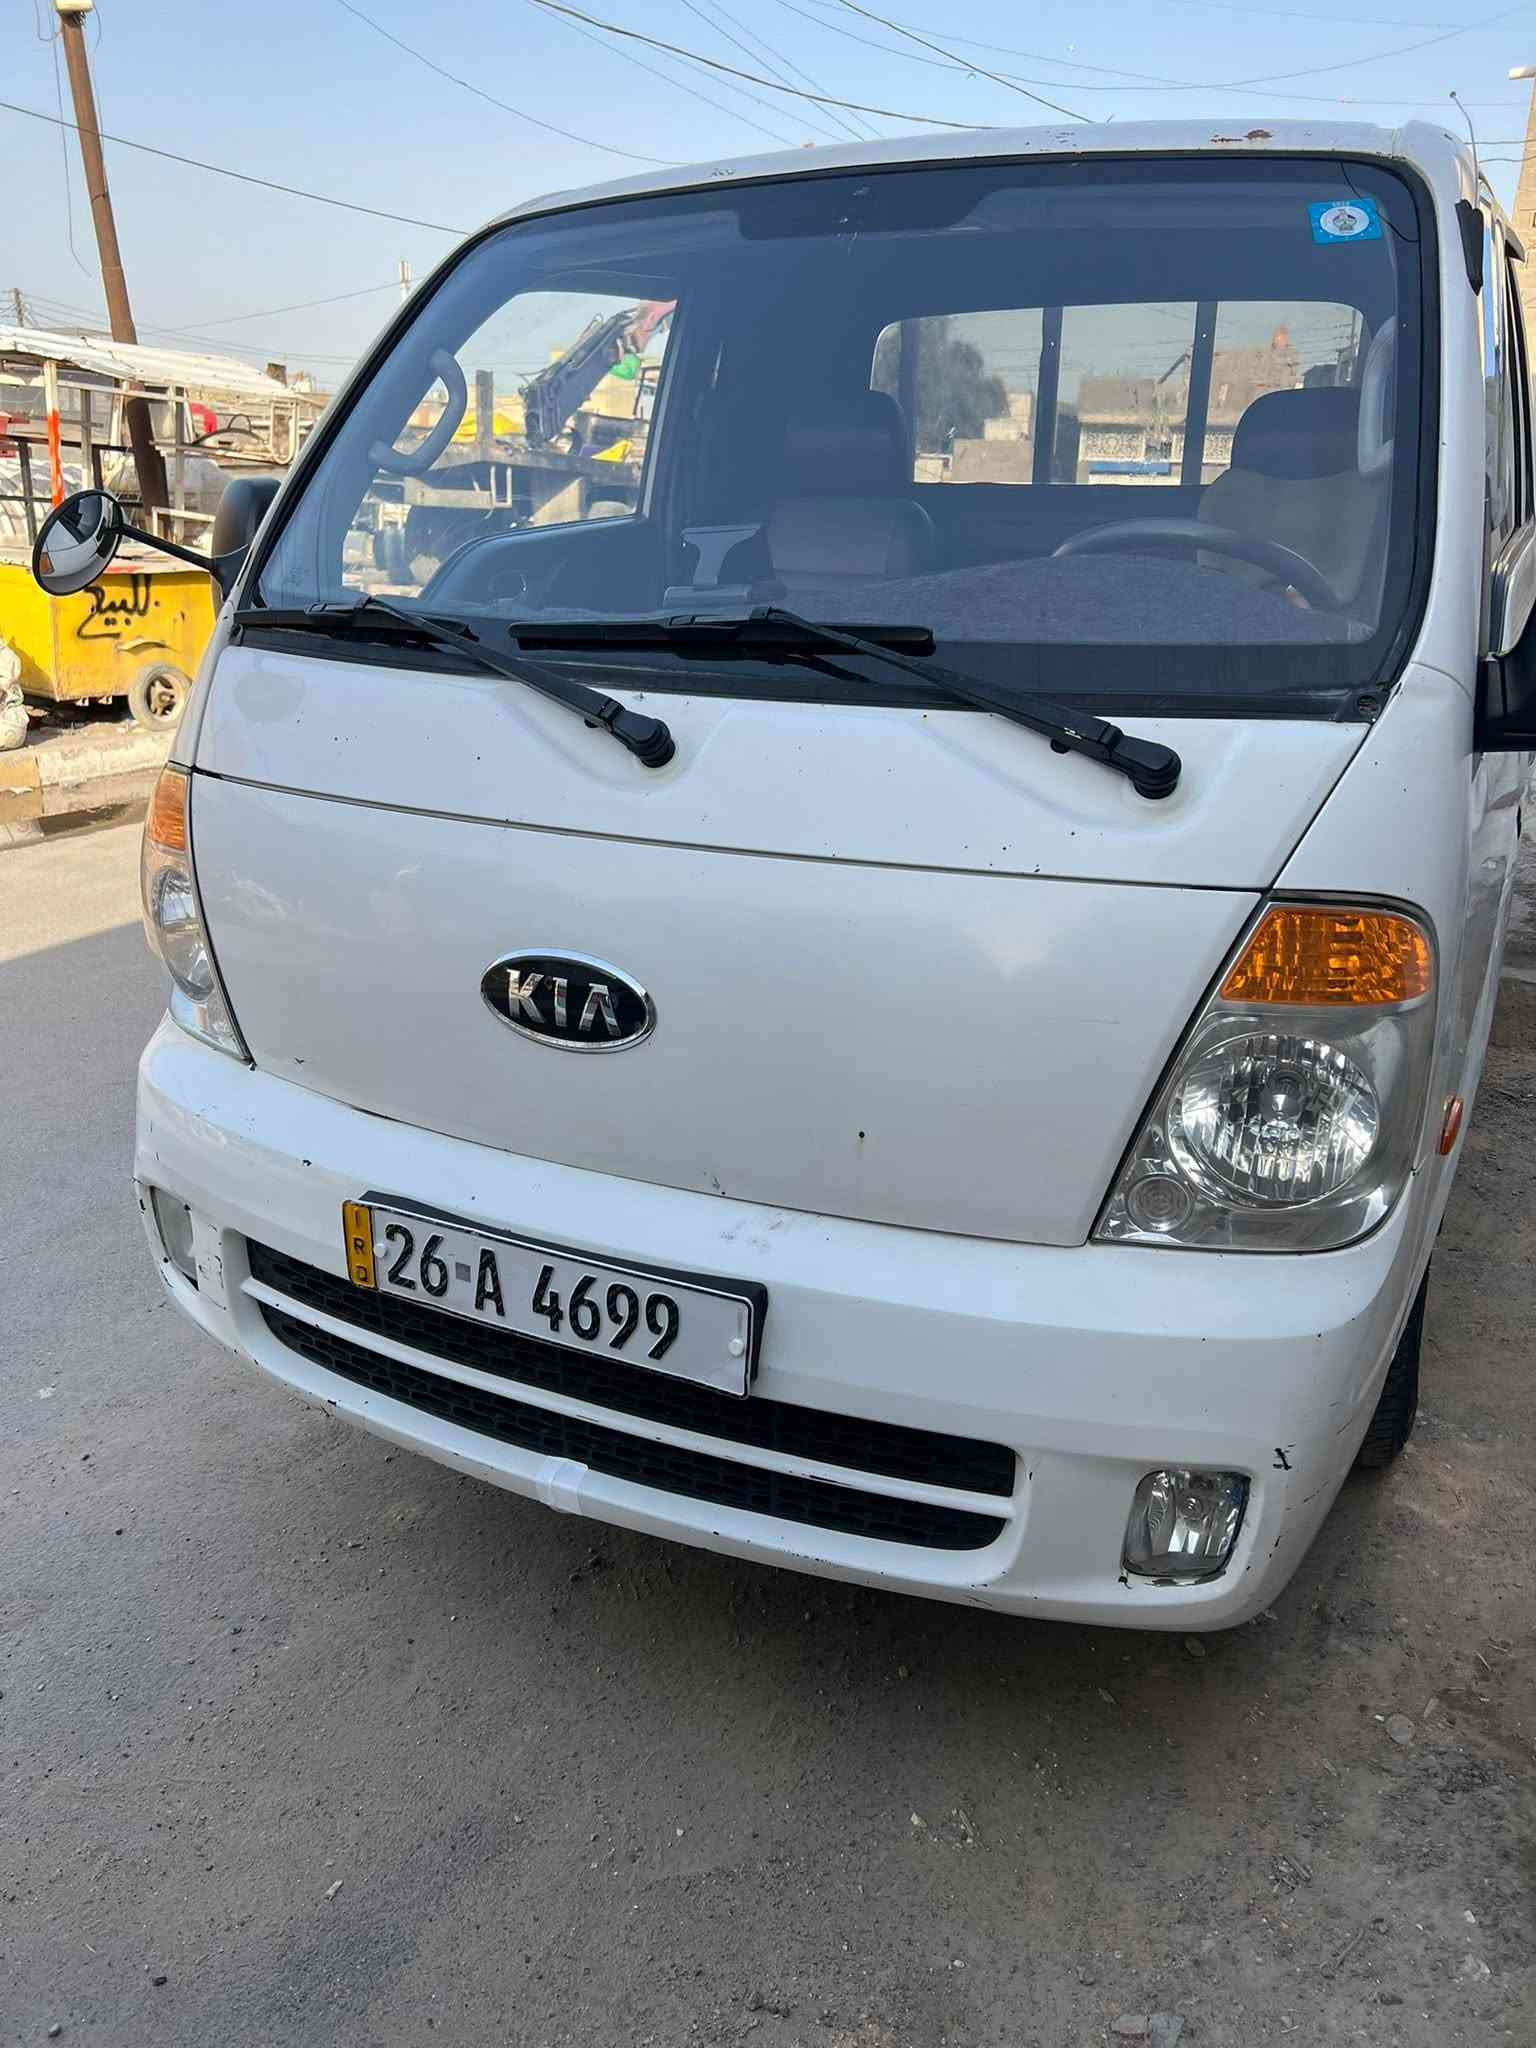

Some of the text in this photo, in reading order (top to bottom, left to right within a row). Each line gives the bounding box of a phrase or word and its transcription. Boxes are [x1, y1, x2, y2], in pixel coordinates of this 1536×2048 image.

[506, 968, 623, 1037] KIA
[383, 1222, 681, 1361] 26 A 4699
